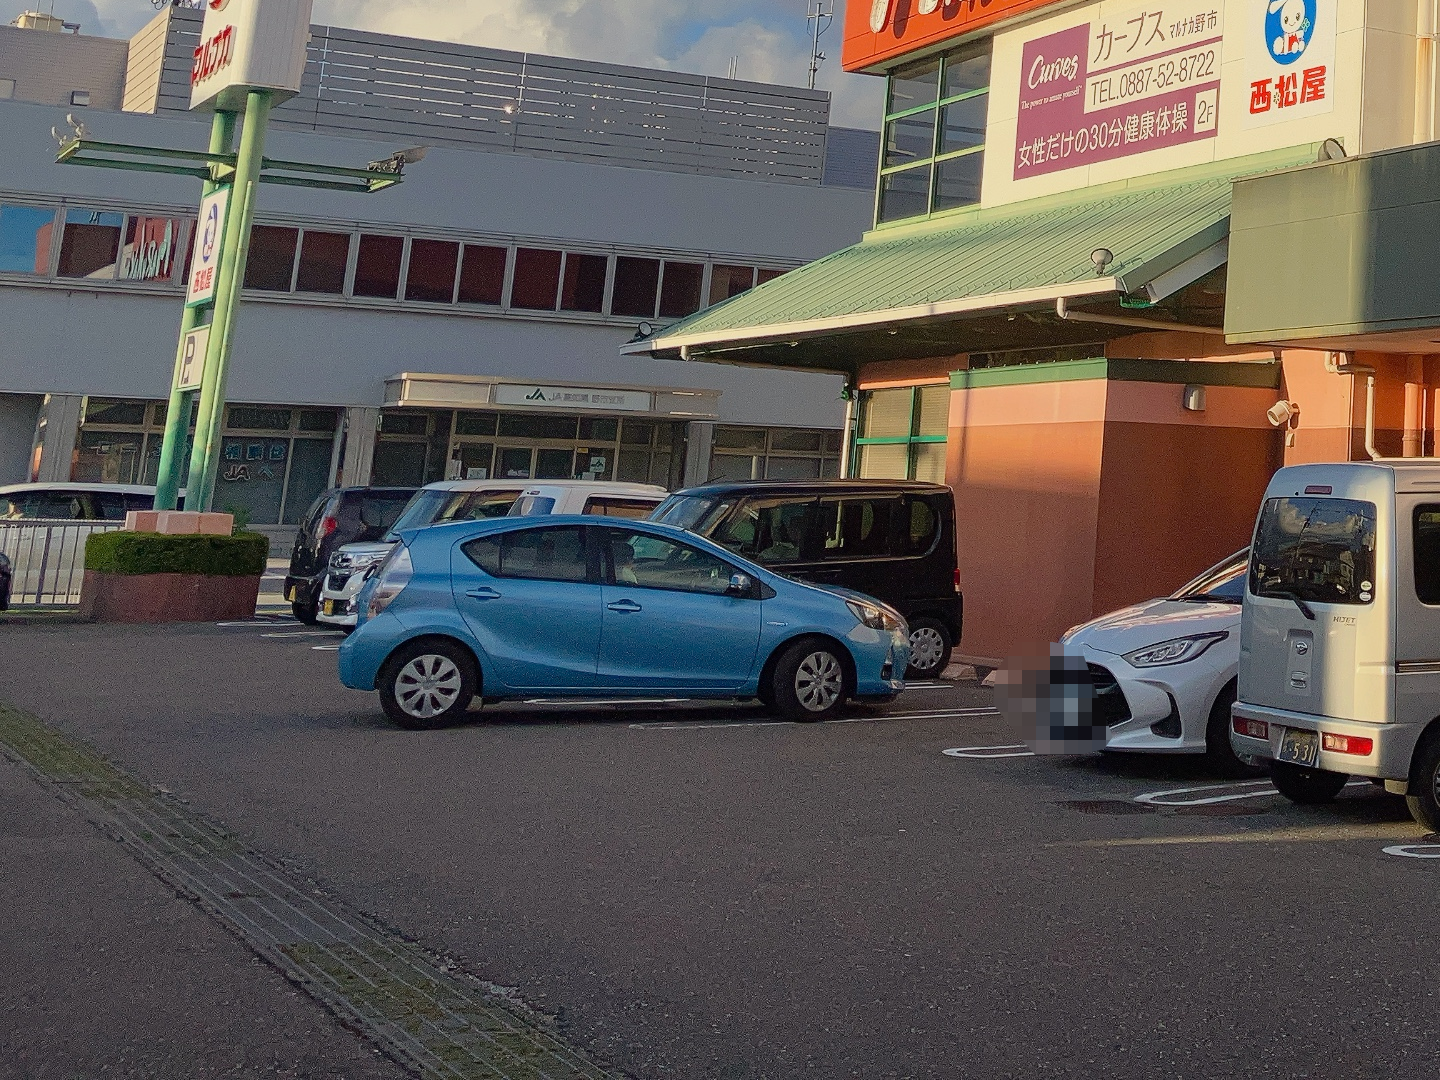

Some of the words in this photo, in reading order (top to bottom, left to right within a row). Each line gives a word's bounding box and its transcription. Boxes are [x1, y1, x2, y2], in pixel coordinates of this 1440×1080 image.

[1093, 11, 1166, 64] カーブス
[1169, 9, 1218, 39] マルナカ野市
[1027, 54, 1079, 90] Curves
[1090, 49, 1215, 106] TEL.0887-52-8722
[1249, 65, 1327, 115] 西松屋
[1017, 101, 1189, 170] 女性だけの30分健康体操
[1197, 100, 1214, 125] 2F
